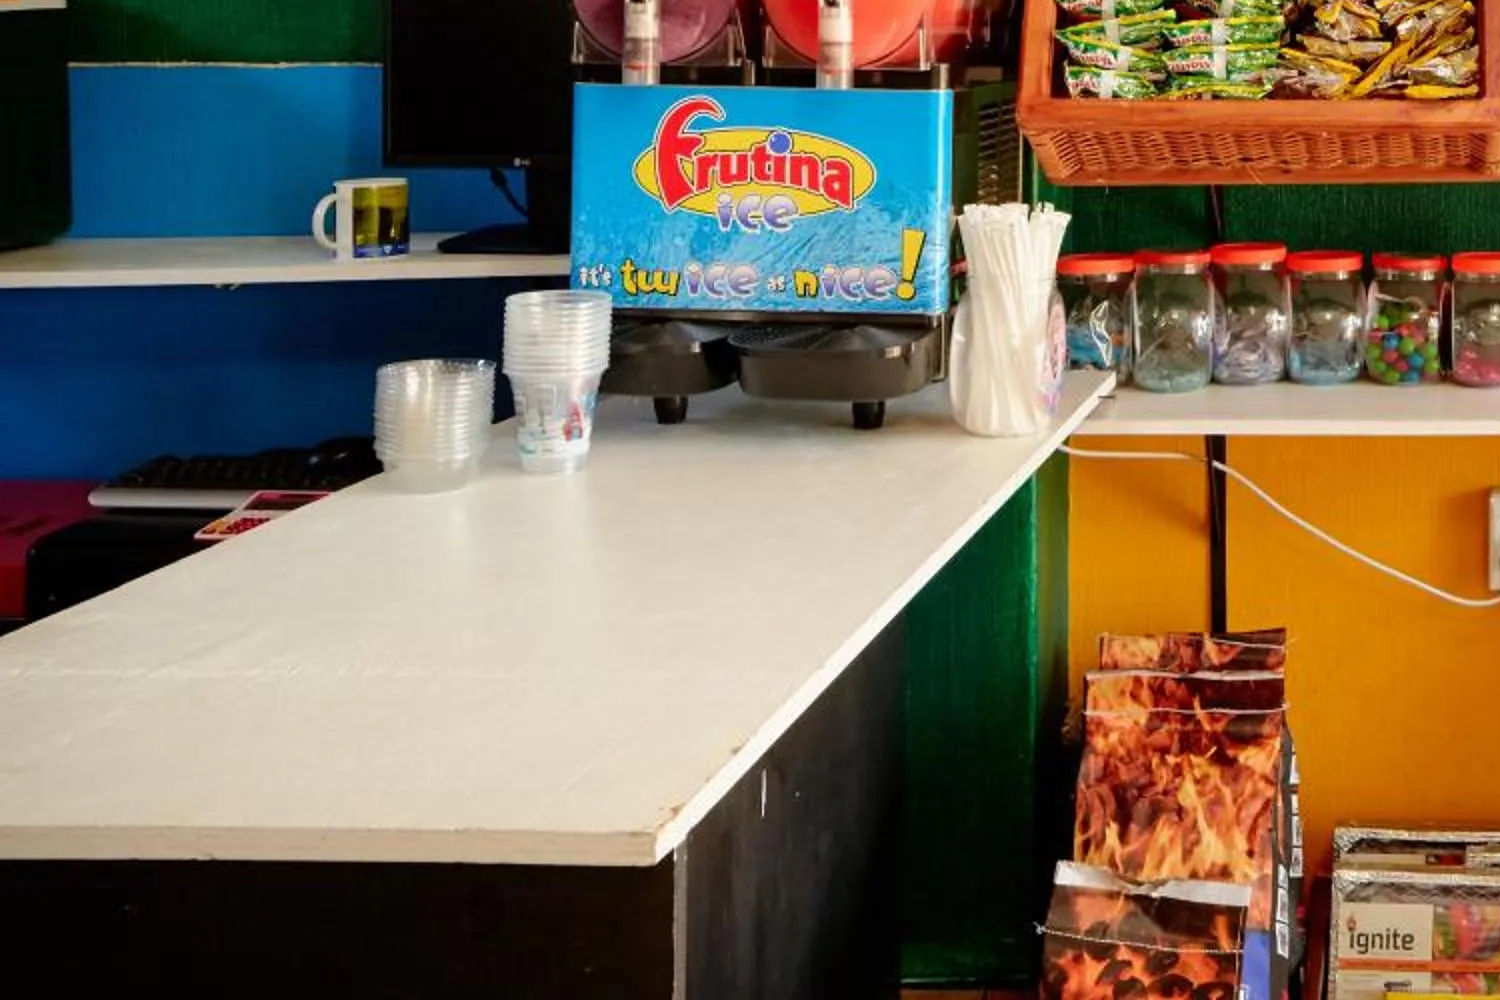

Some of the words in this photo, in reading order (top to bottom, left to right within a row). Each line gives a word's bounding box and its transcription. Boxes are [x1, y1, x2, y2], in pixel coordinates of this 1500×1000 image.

[656, 95, 854, 213] Frutina
[716, 190, 799, 232] ice
[767, 274, 786, 293] as
[793, 228, 926, 300] nice!
[1347, 920, 1415, 954] ignite
